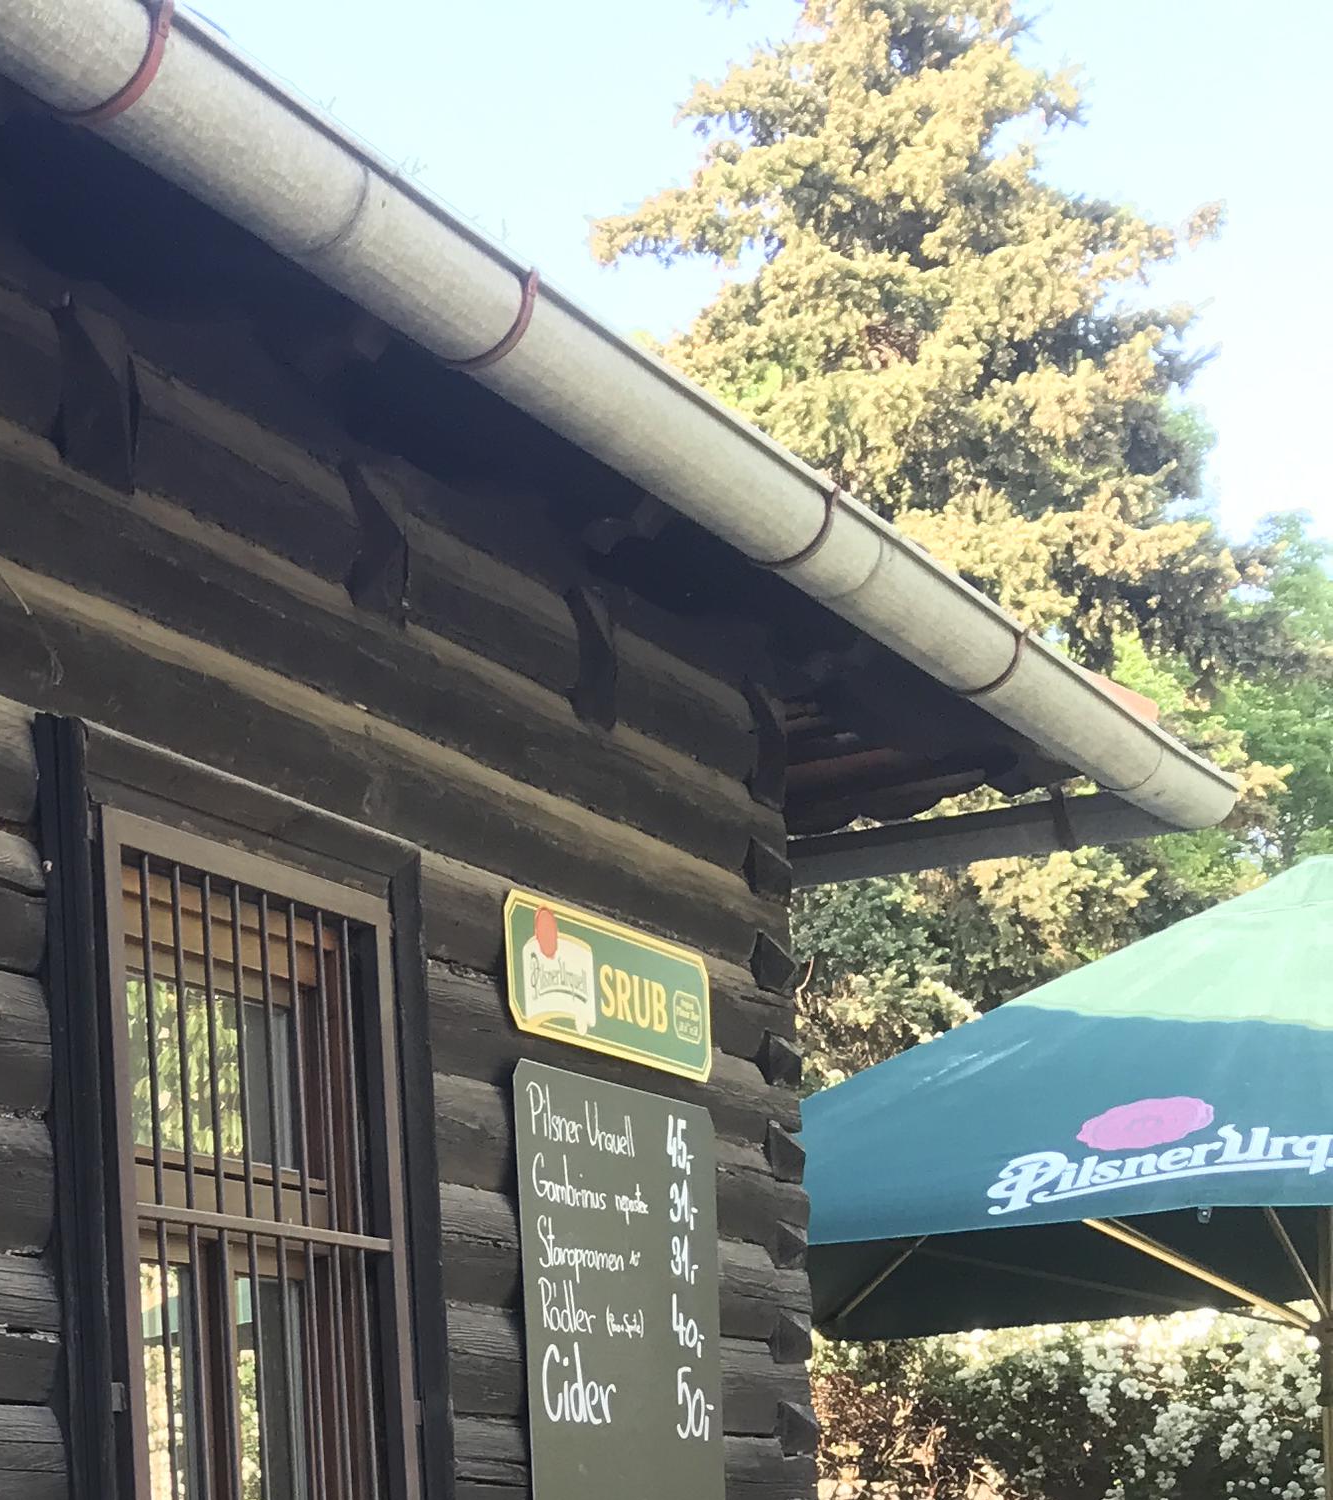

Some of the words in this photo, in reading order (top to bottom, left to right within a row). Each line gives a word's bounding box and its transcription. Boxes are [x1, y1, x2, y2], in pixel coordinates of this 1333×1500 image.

[598, 963, 669, 1034] SRUB
[525, 1080, 584, 1144] Pilsner
[584, 1099, 636, 1158] Urquell
[531, 1151, 608, 1211] Gambrinus
[985, 1140, 1224, 1216] Pilsner
[1215, 1123, 1333, 1176] Urq
[536, 1213, 625, 1284] Staropramen
[536, 1276, 597, 1334] Rádler
[541, 1341, 618, 1426] Cider
